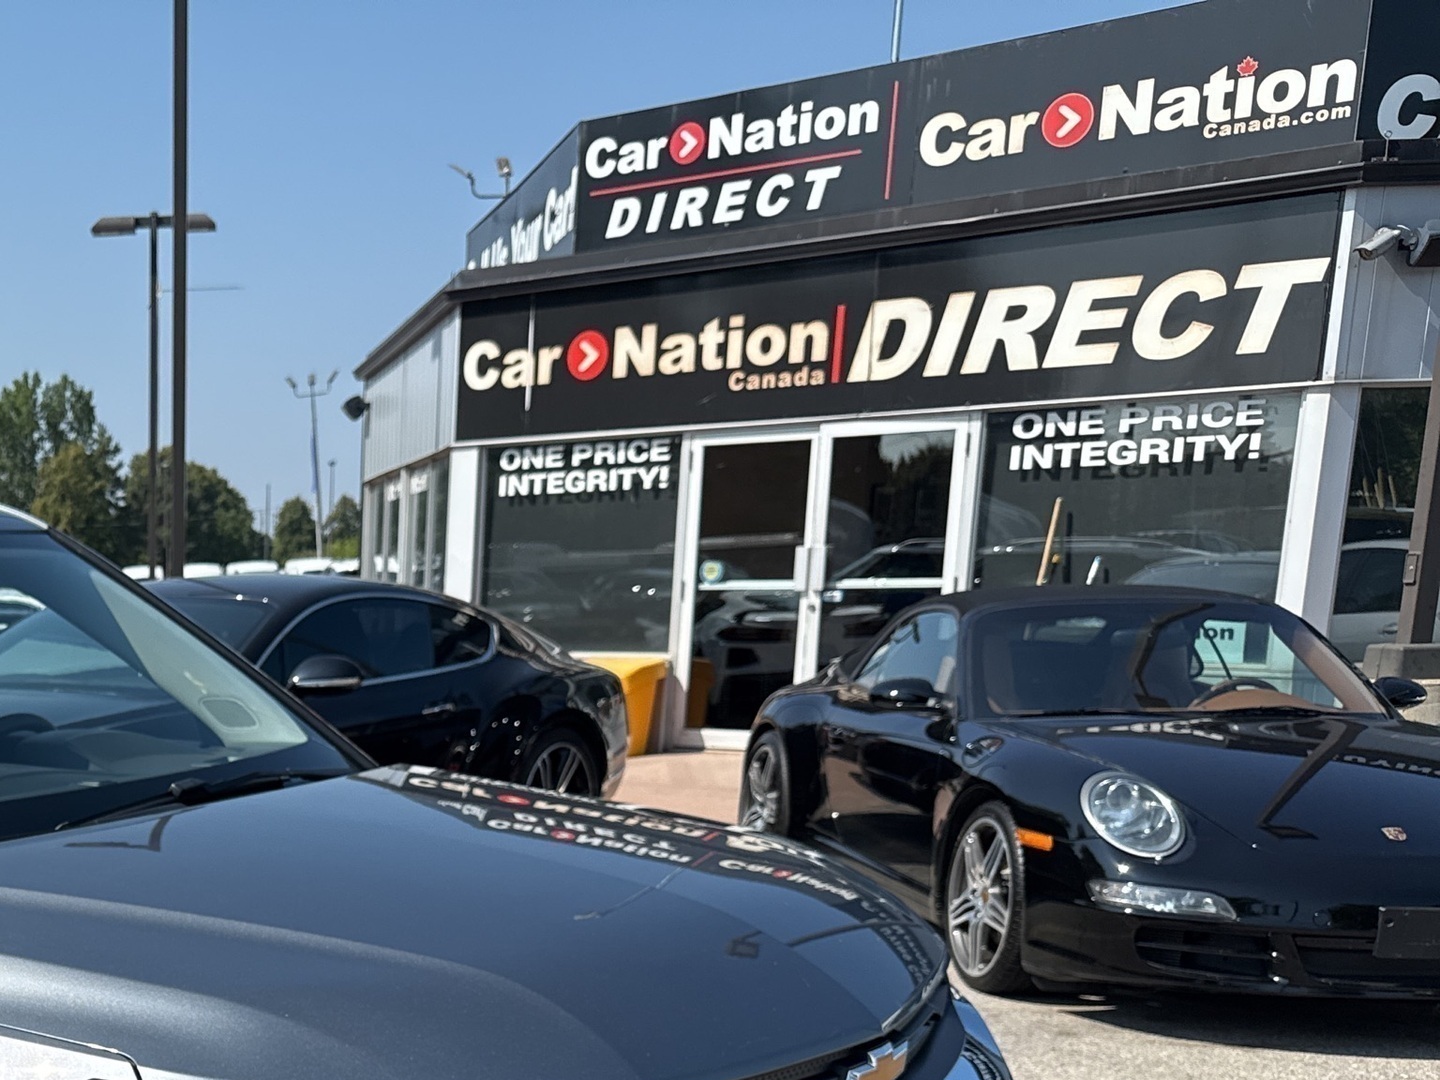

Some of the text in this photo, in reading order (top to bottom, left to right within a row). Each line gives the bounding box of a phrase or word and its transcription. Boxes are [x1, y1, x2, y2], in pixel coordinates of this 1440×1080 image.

[919, 56, 1358, 168] Car Nation
[1203, 104, 1352, 140] Canada.com
[585, 100, 880, 179] Car Nation
[604, 165, 842, 240] DIRECT
[511, 213, 544, 265] Your
[463, 256, 1332, 392] Car Nation DIRECT
[728, 366, 825, 393] Canada
[1011, 399, 1267, 440] ONE PRICE
[498, 437, 672, 472] ONE PRICE
[1009, 432, 1262, 471] INTEGRITY!
[497, 464, 671, 498] INTEGRITY!
